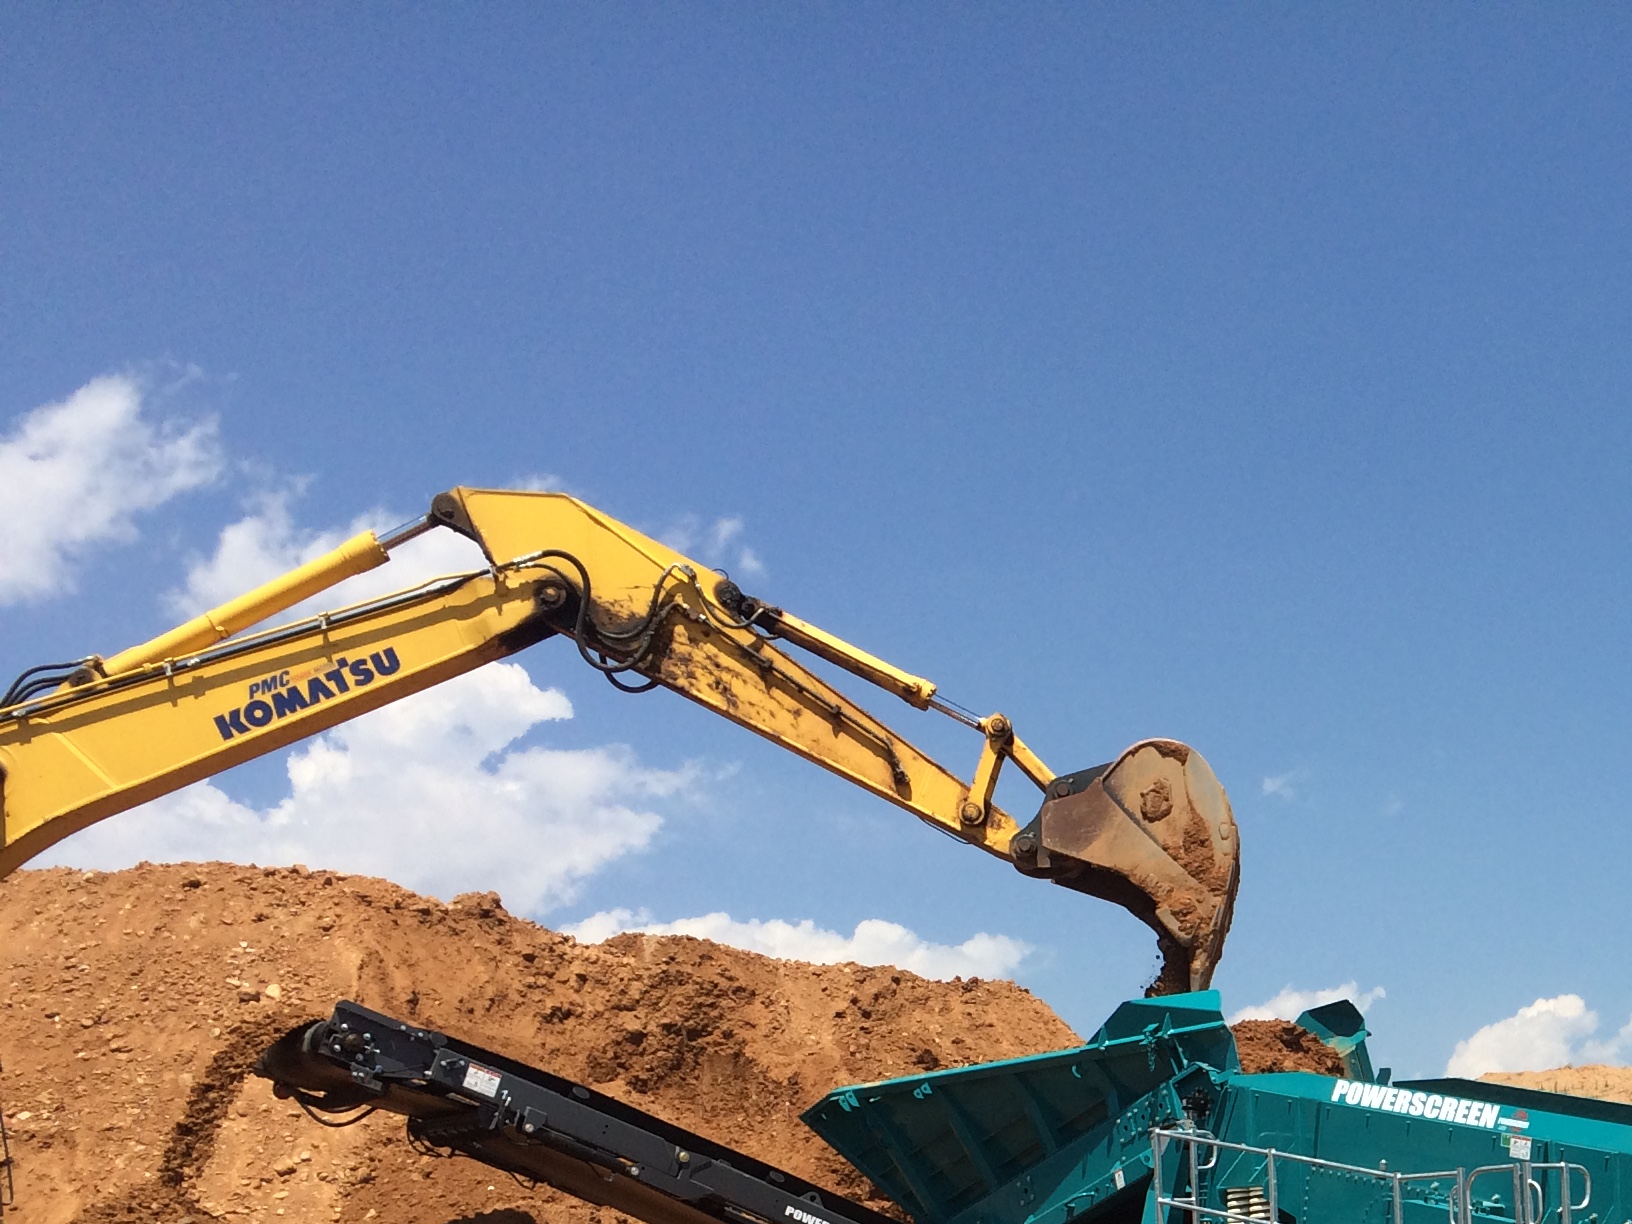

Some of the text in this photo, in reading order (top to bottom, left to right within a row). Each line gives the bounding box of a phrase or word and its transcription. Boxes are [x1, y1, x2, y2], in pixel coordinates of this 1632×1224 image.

[213, 646, 401, 741] KOMATSU
[248, 670, 291, 700] PMC
[1331, 1079, 1500, 1129] POWERSCREEN
